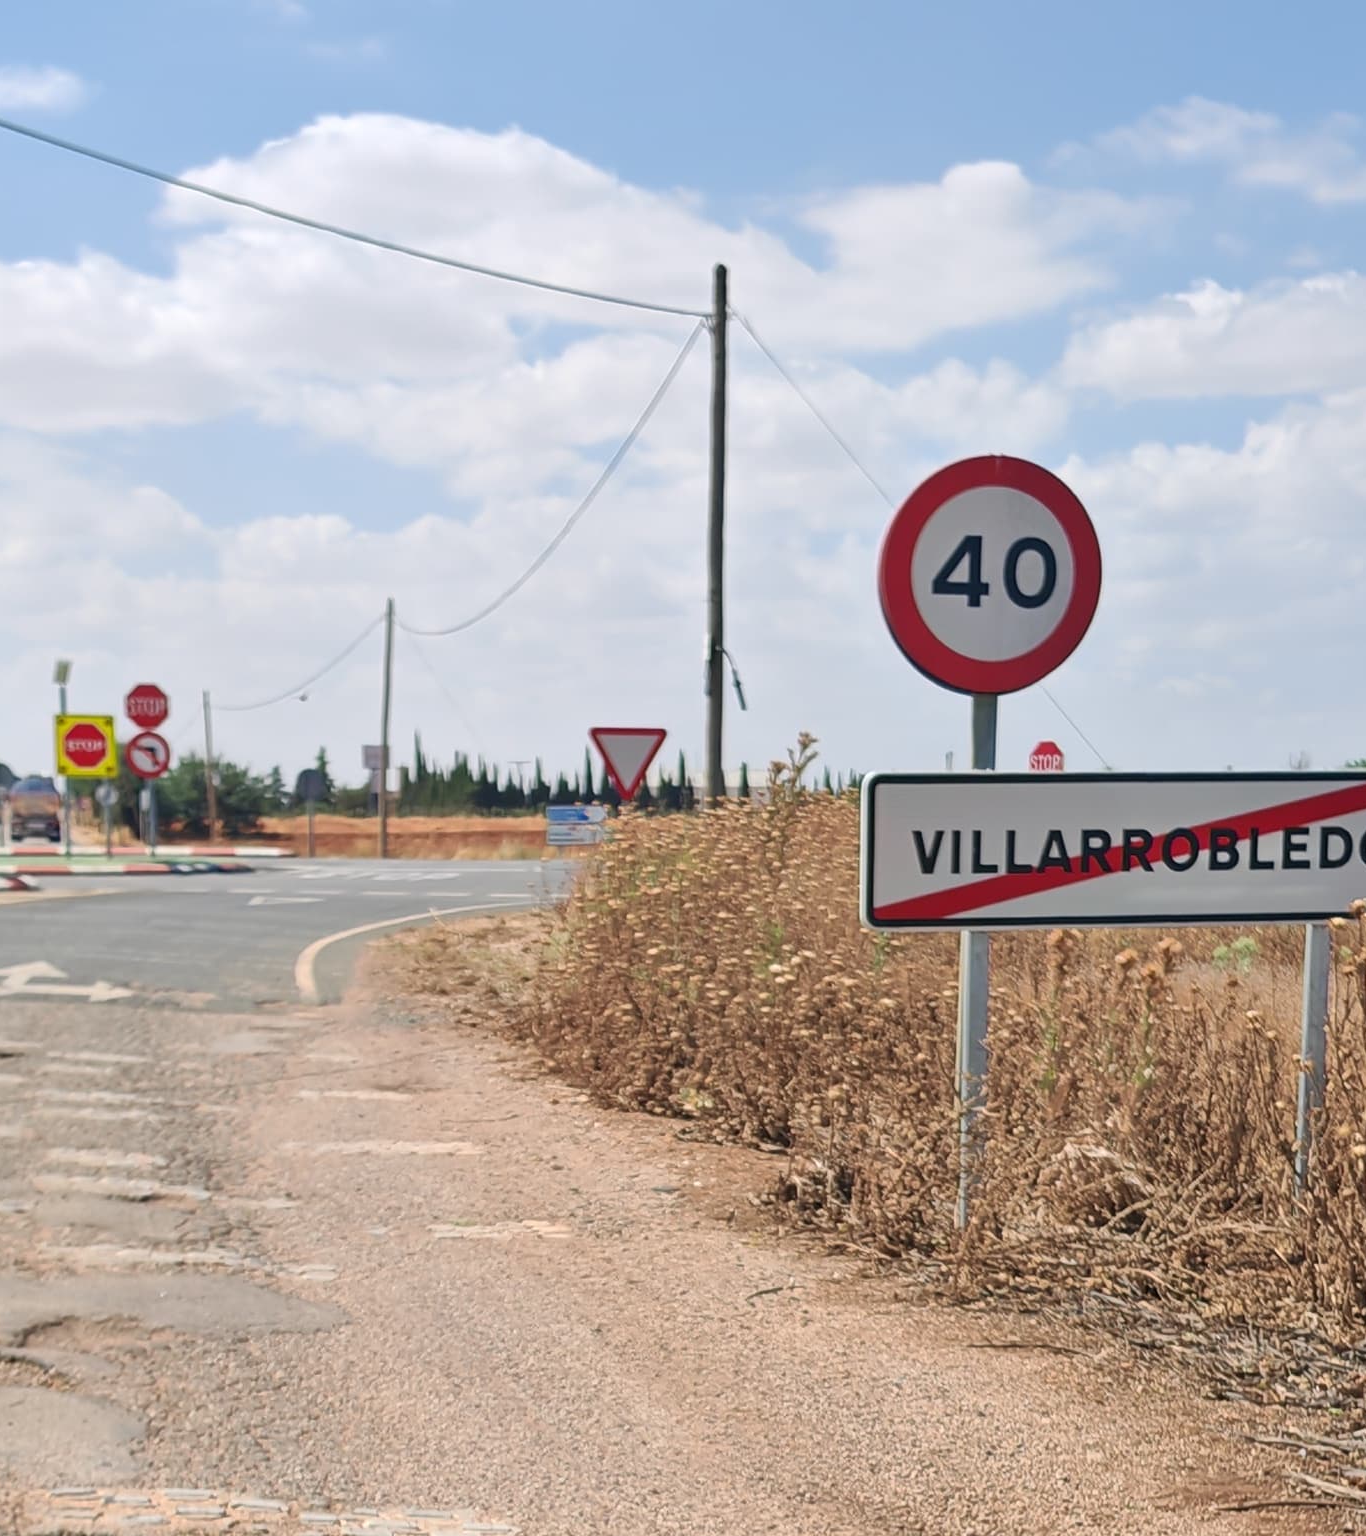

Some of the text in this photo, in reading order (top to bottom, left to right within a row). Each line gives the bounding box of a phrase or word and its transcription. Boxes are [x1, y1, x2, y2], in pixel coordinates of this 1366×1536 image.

[932, 535, 1057, 608] 40
[128, 697, 166, 714] STOP
[67, 740, 103, 753] STOP
[1030, 753, 1061, 771] STOP
